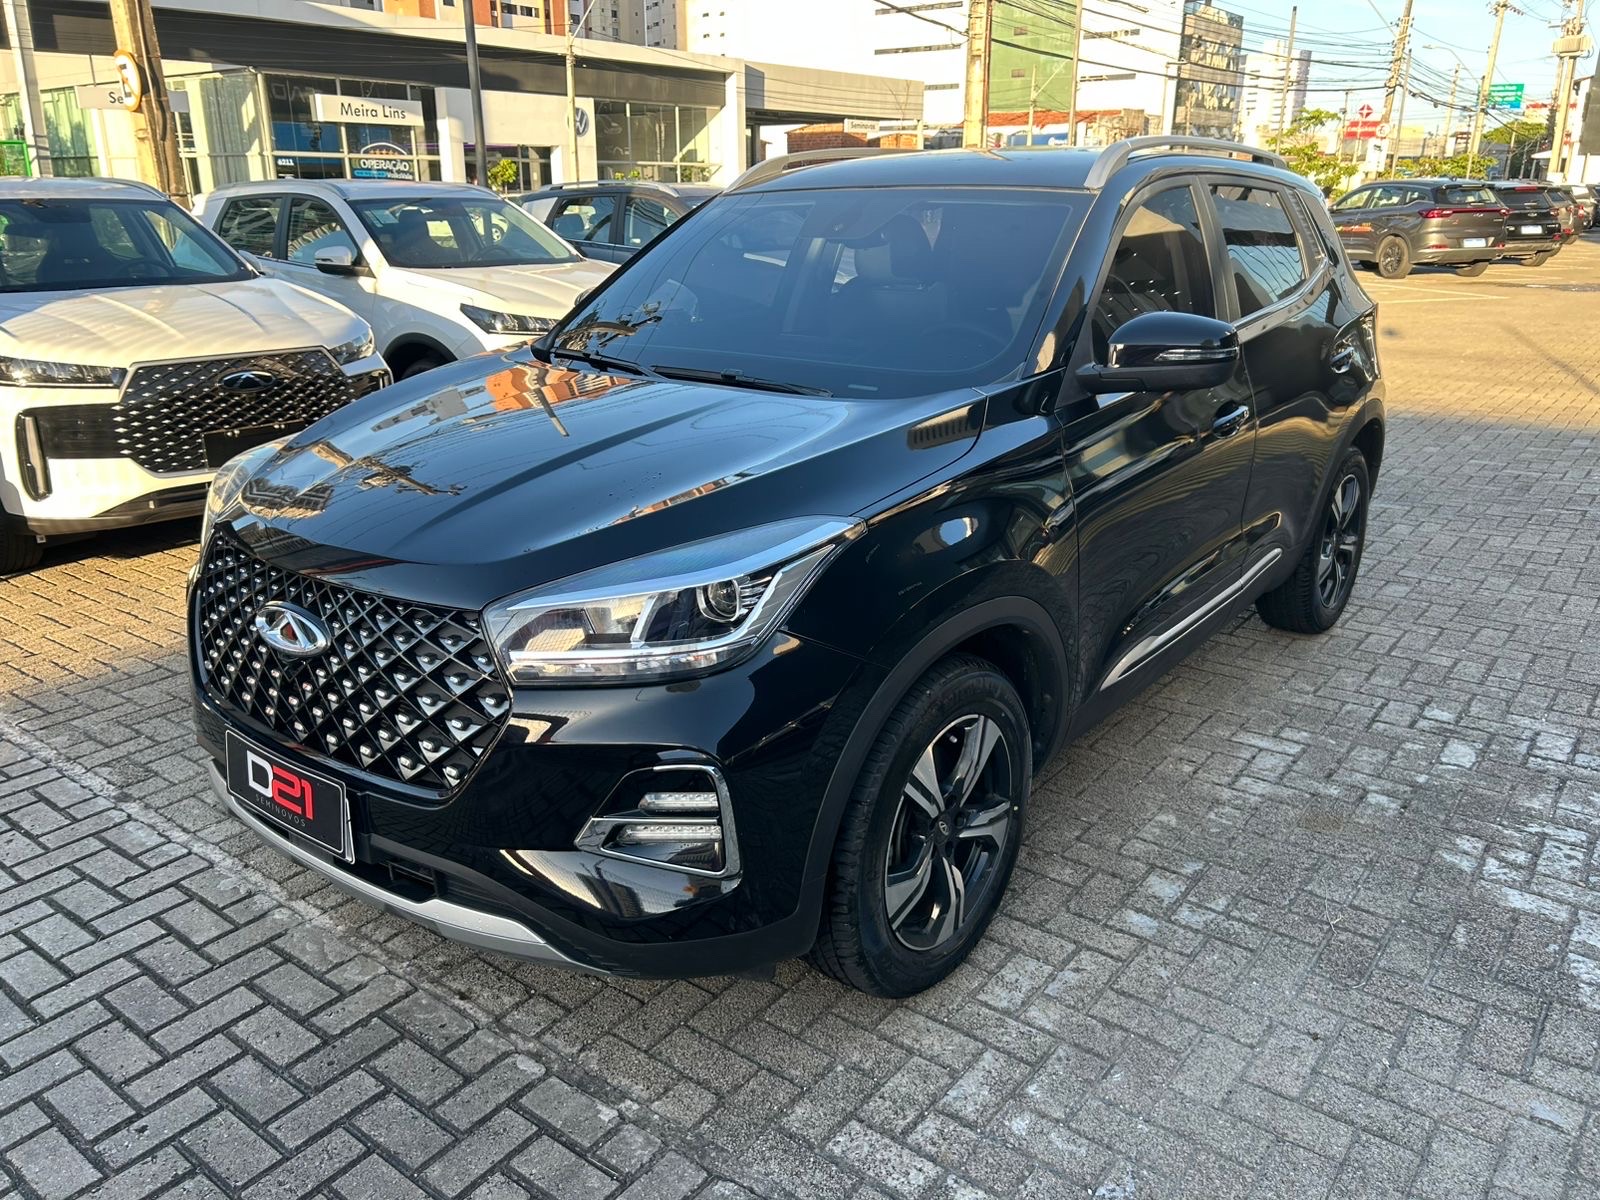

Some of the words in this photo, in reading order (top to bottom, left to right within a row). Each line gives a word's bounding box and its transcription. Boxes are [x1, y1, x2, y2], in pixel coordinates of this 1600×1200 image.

[340, 102, 378, 117] Meira
[382, 105, 406, 119] Lins
[360, 158, 409, 173] OPERAÇÃO
[247, 750, 313, 820] D21
[255, 793, 306, 827] SEMINOVOS
